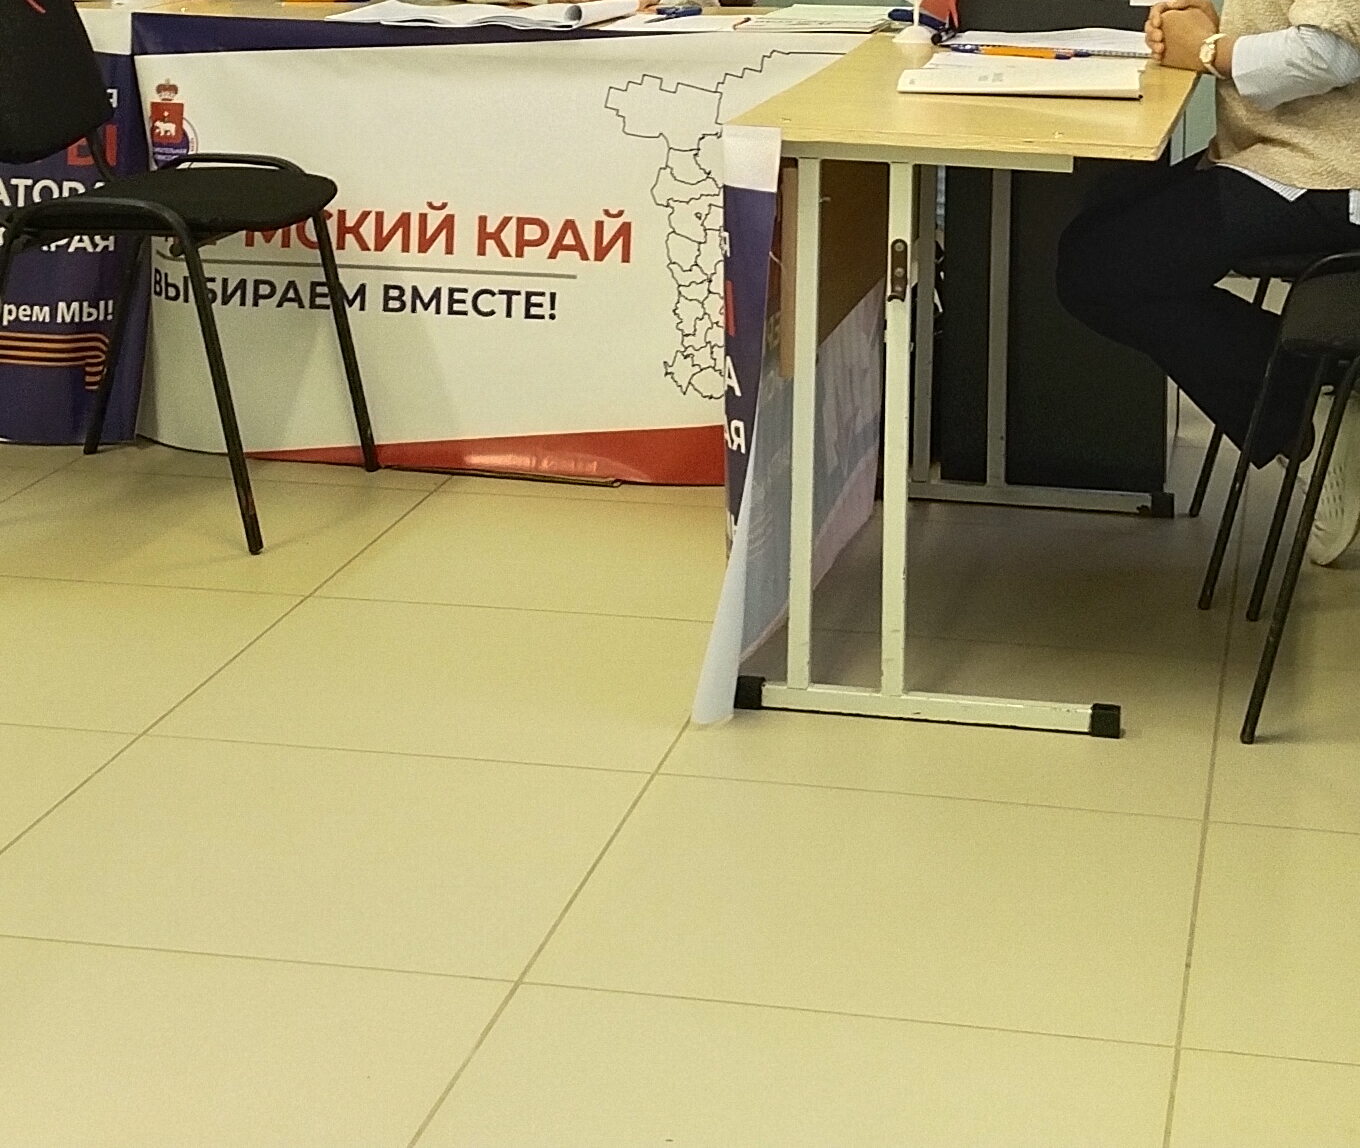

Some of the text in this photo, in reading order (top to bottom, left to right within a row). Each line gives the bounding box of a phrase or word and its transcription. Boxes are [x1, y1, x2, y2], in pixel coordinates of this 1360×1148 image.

[244, 201, 632, 264] МСКИЙ КРАЙ
[56, 299, 114, 323] МЫ!
[153, 267, 558, 320] ВЫБИРАЕМ ВМЕСТЕ!
